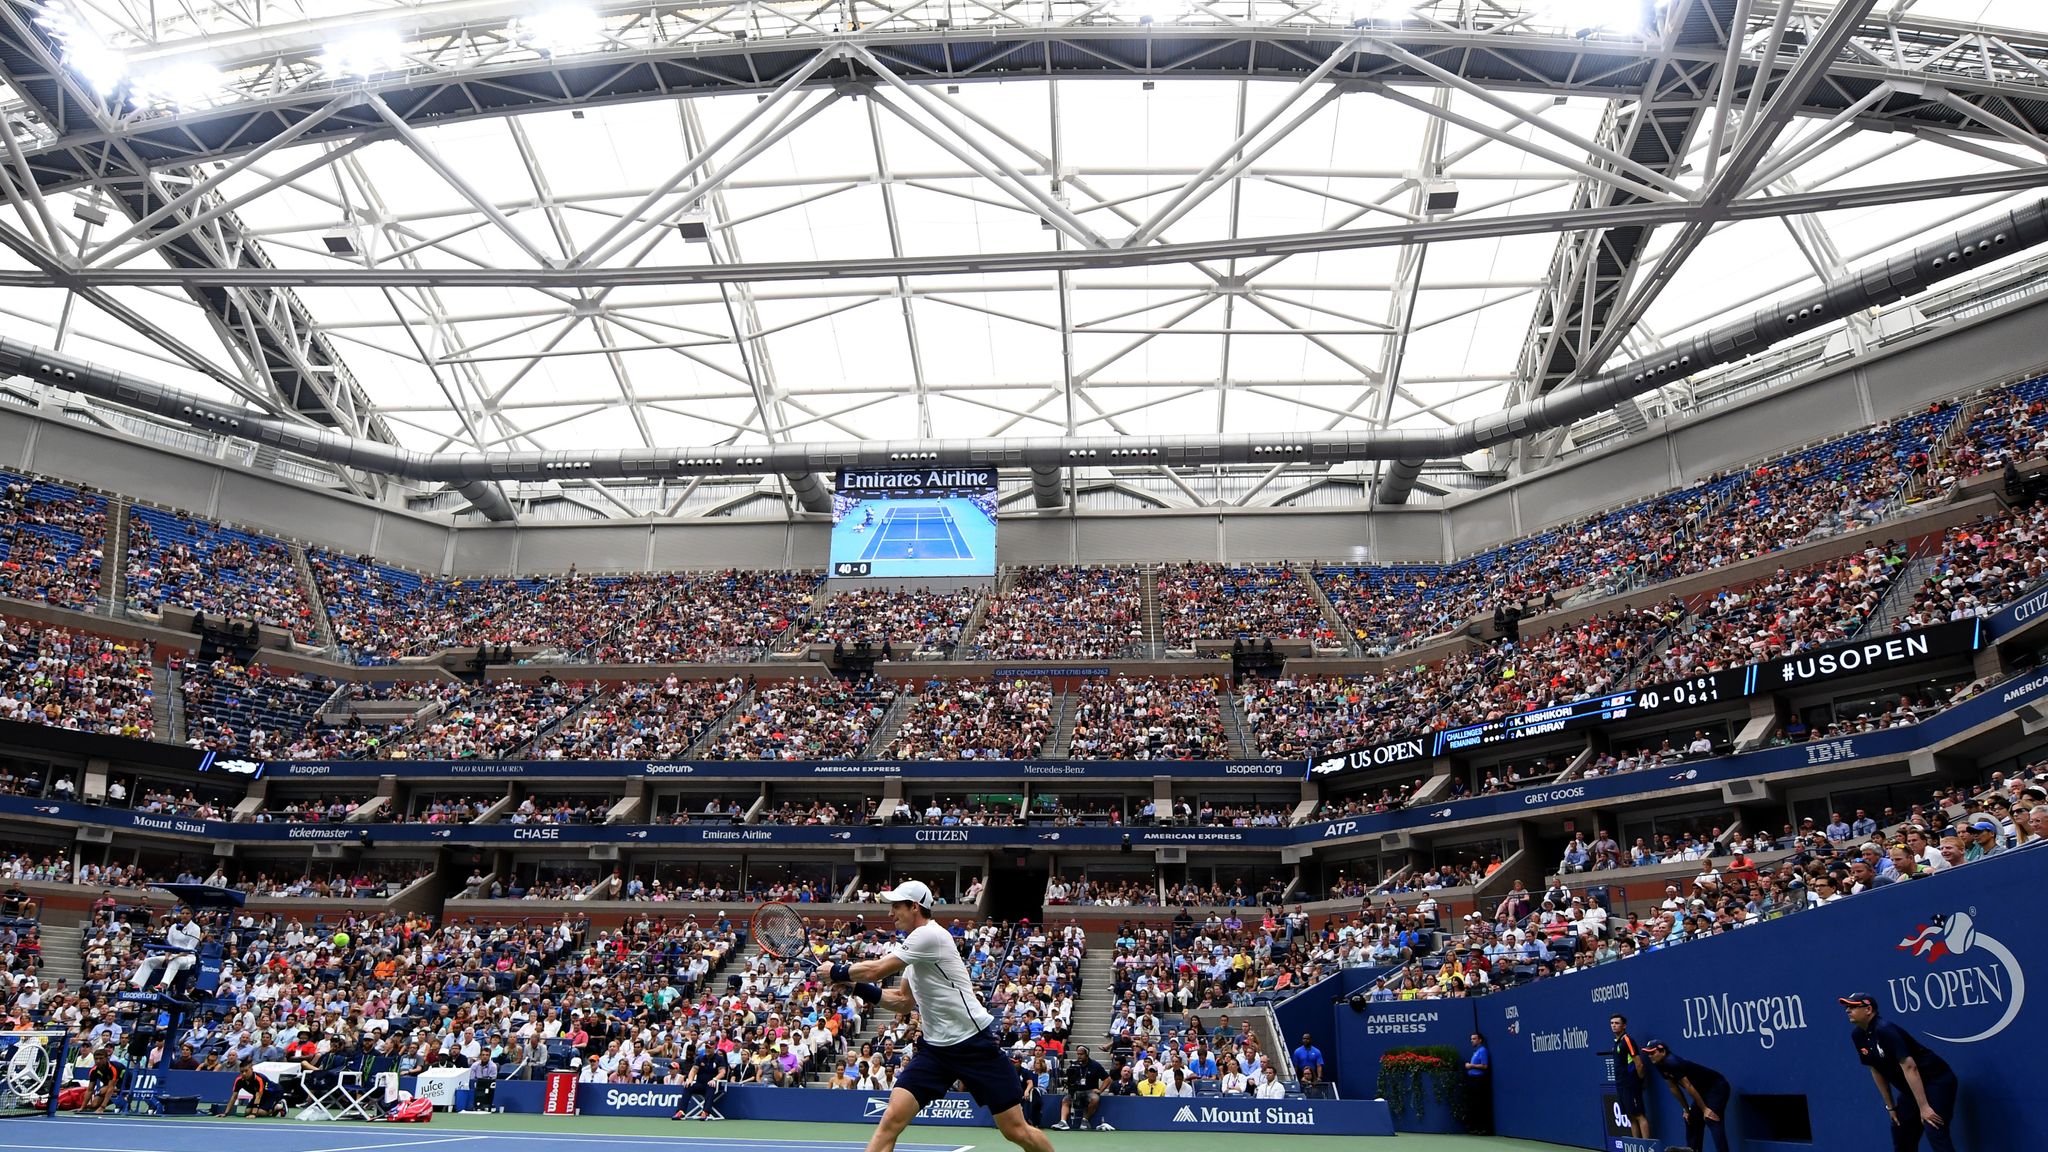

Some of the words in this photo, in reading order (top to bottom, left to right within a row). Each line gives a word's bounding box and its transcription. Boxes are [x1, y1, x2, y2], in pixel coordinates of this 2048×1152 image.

[844, 471, 922, 489] Emirates
[926, 470, 988, 487] Airline
[838, 564, 851, 574] 40
[859, 564, 867, 574] 0
[1782, 634, 1929, 682] #USOPEN
[1686, 681, 1693, 691] 1
[1697, 678, 1706, 689] 6
[1709, 676, 1716, 686] 1
[1639, 691, 1659, 709] 40
[1673, 686, 1685, 703] 0
[1688, 694, 1697, 704] 6
[1699, 691, 1708, 702] 4
[1711, 689, 1718, 700] 1
[1514, 717, 1524, 726] K.
[1524, 707, 1573, 724] NISHIKORI
[1446, 728, 1483, 742] CHALLENGES
[1515, 729, 1525, 738] A.
[1525, 720, 1565, 736] MURRAY
[1450, 736, 1481, 749] REMAINING
[1350, 750, 1371, 769] US
[1374, 739, 1424, 765] OPEN
[1806, 739, 1855, 764] IBM
[289, 764, 330, 775] #usopen
[451, 765, 470, 773] POLO
[471, 765, 495, 773] RALPH
[495, 765, 524, 773] LAUREN
[646, 763, 691, 775] Spectrum
[1023, 764, 1085, 774] Mercedes-Benz
[1225, 763, 1283, 775] usopen.org
[1524, 792, 1548, 805] GREY
[1551, 787, 1585, 801] GOOSE
[133, 815, 172, 829] Mount
[175, 821, 206, 833] Sinai
[289, 827, 350, 838] ticketmaster
[513, 829, 560, 839] CHASE
[702, 830, 740, 839] Emirates
[742, 830, 772, 839] Airline
[915, 830, 968, 841] CITIZEN
[122, 991, 158, 1000] usopen.org
[1591, 981, 1629, 1003] usopen.org
[1888, 975, 1921, 1014] US
[1924, 963, 2003, 1010] OPEN
[1367, 1011, 1439, 1024] AMERICAN
[1505, 1005, 1519, 1019] USTA
[1682, 992, 1807, 1049] J.P.Morgan
[1367, 1023, 1427, 1035] EXPRESS
[1531, 1028, 1562, 1053] Emirates
[1562, 1026, 1589, 1050] Airline
[547, 1075, 560, 1113] Wilson
[566, 1076, 577, 1113] Wilson
[933, 1099, 971, 1109] STATES
[1200, 1107, 1261, 1124] Mount
[1266, 1106, 1315, 1125] Sinai
